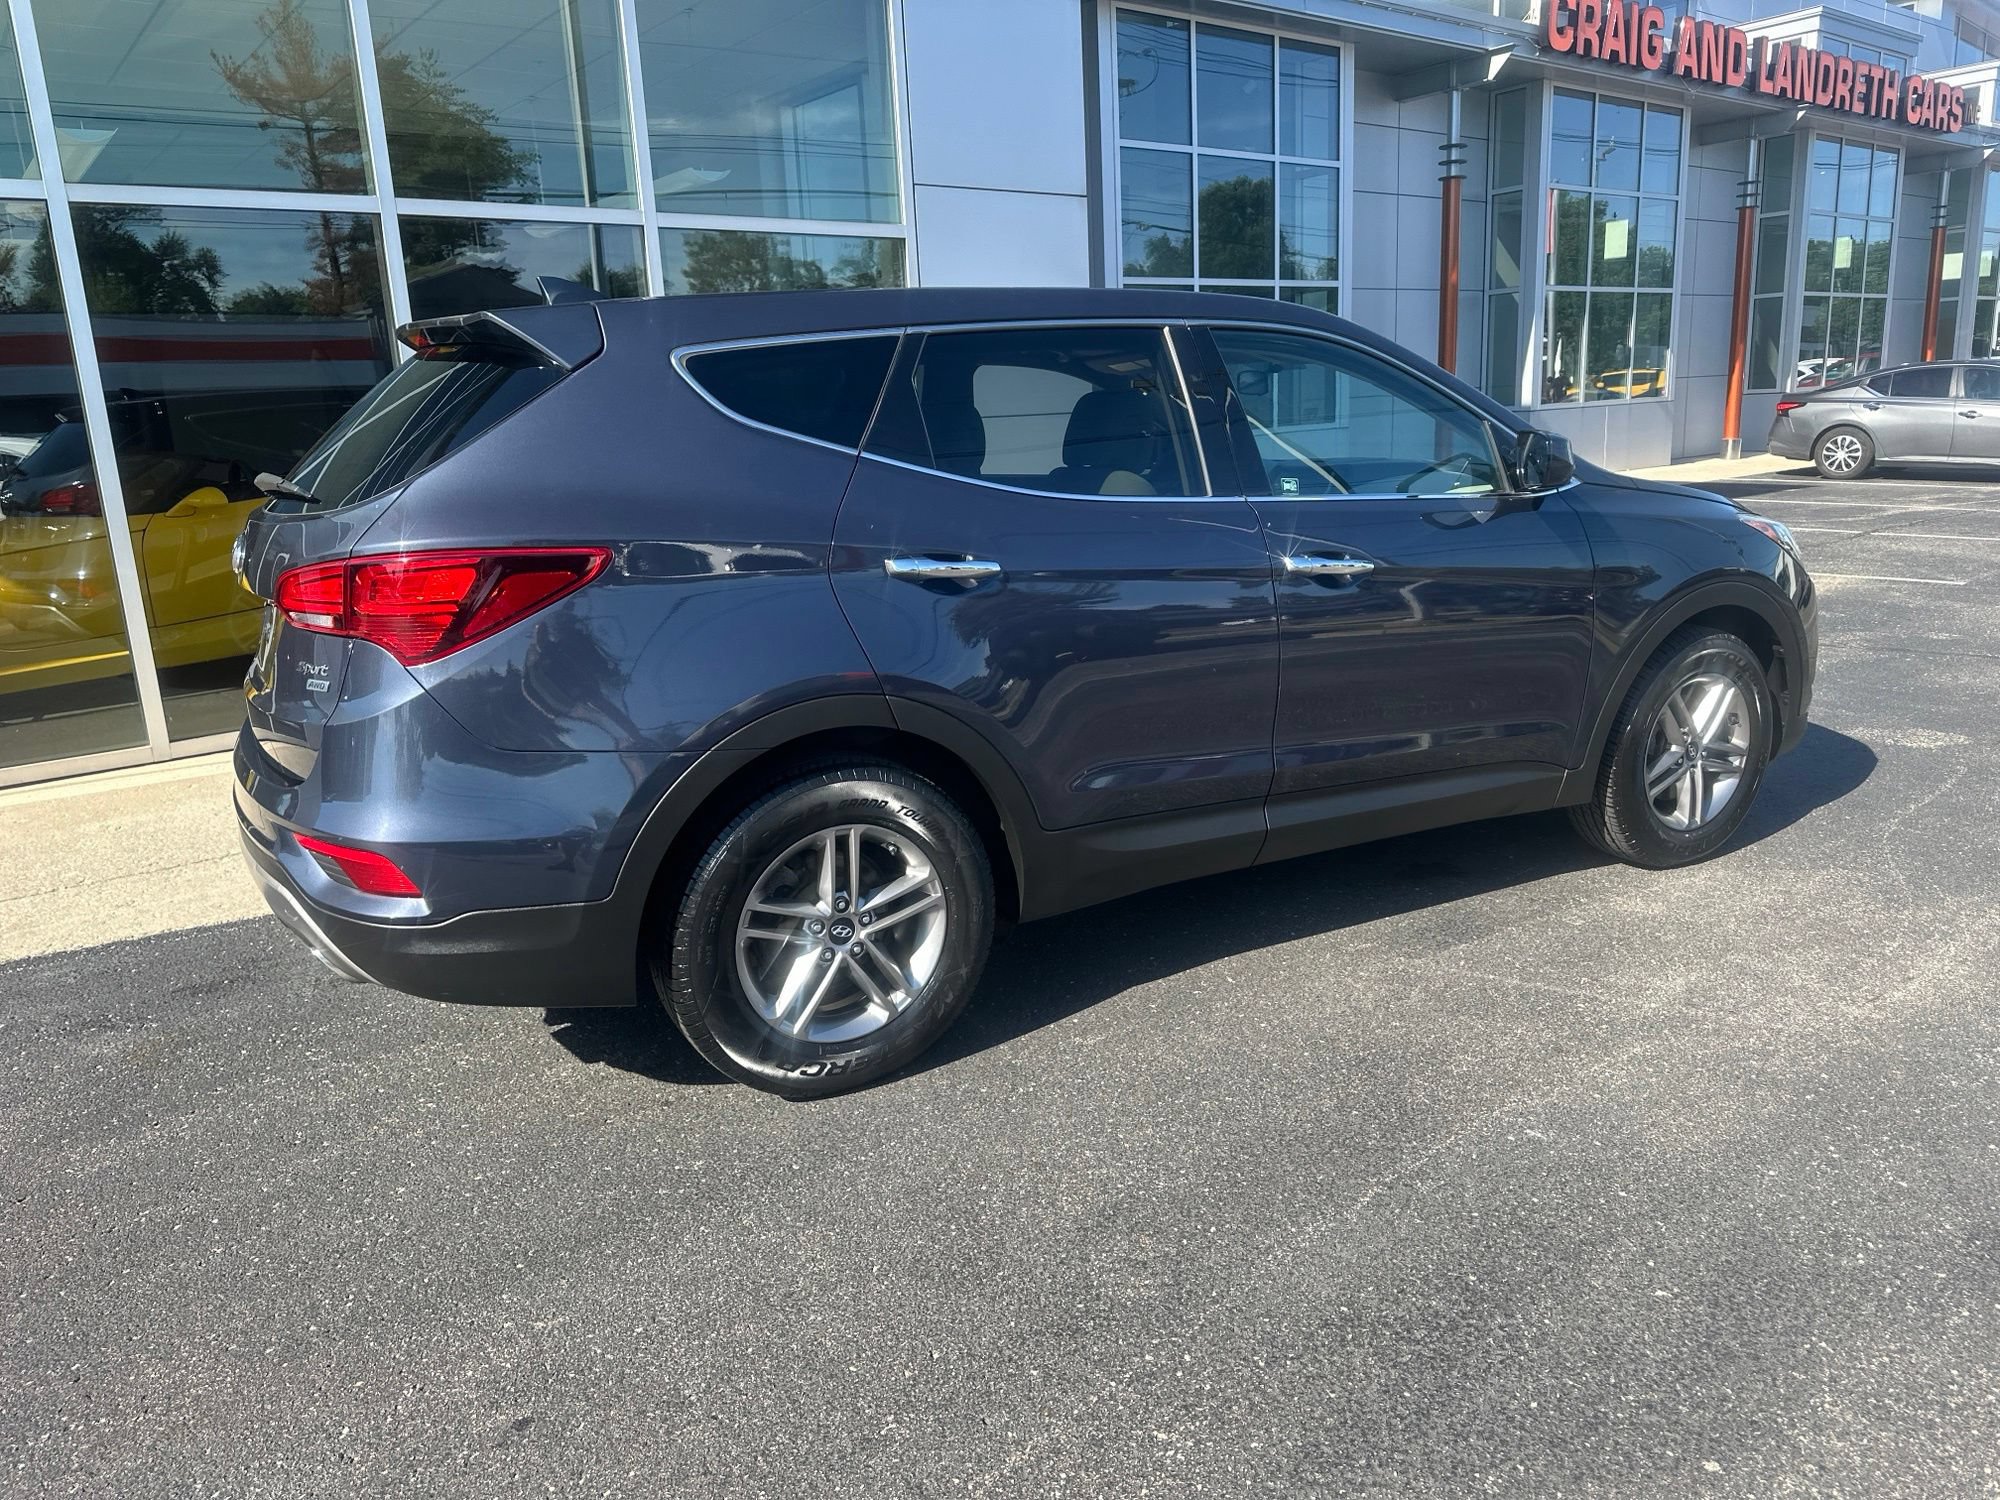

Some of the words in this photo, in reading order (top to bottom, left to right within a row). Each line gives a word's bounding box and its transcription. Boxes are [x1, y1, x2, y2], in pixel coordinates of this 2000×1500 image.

[1547, 0, 1665, 70] CRAIG
[1673, 15, 1747, 87] AND
[1757, 36, 1899, 120] LANDRETH
[1907, 75, 1964, 132] CARS
